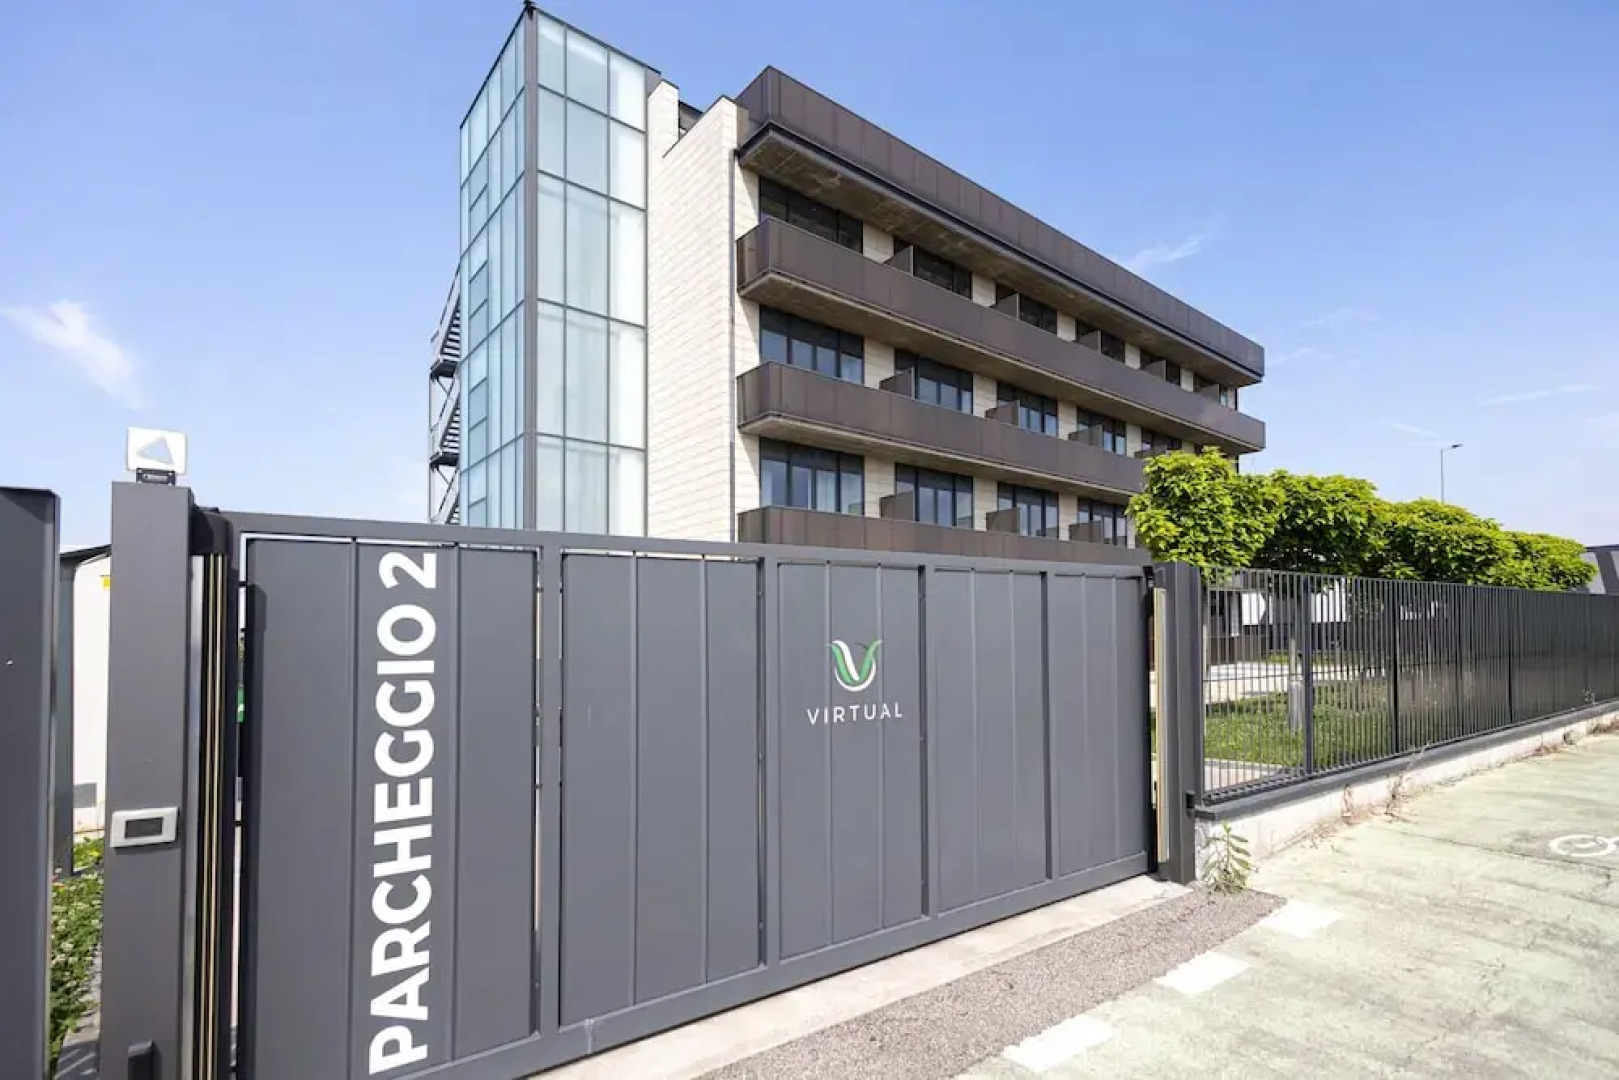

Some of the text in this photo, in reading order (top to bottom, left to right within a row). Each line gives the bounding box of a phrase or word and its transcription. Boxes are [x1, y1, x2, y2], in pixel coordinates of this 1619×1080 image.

[368, 552, 437, 1075] PARCHEGGIO 2
[805, 701, 903, 725] VIRTUAL
